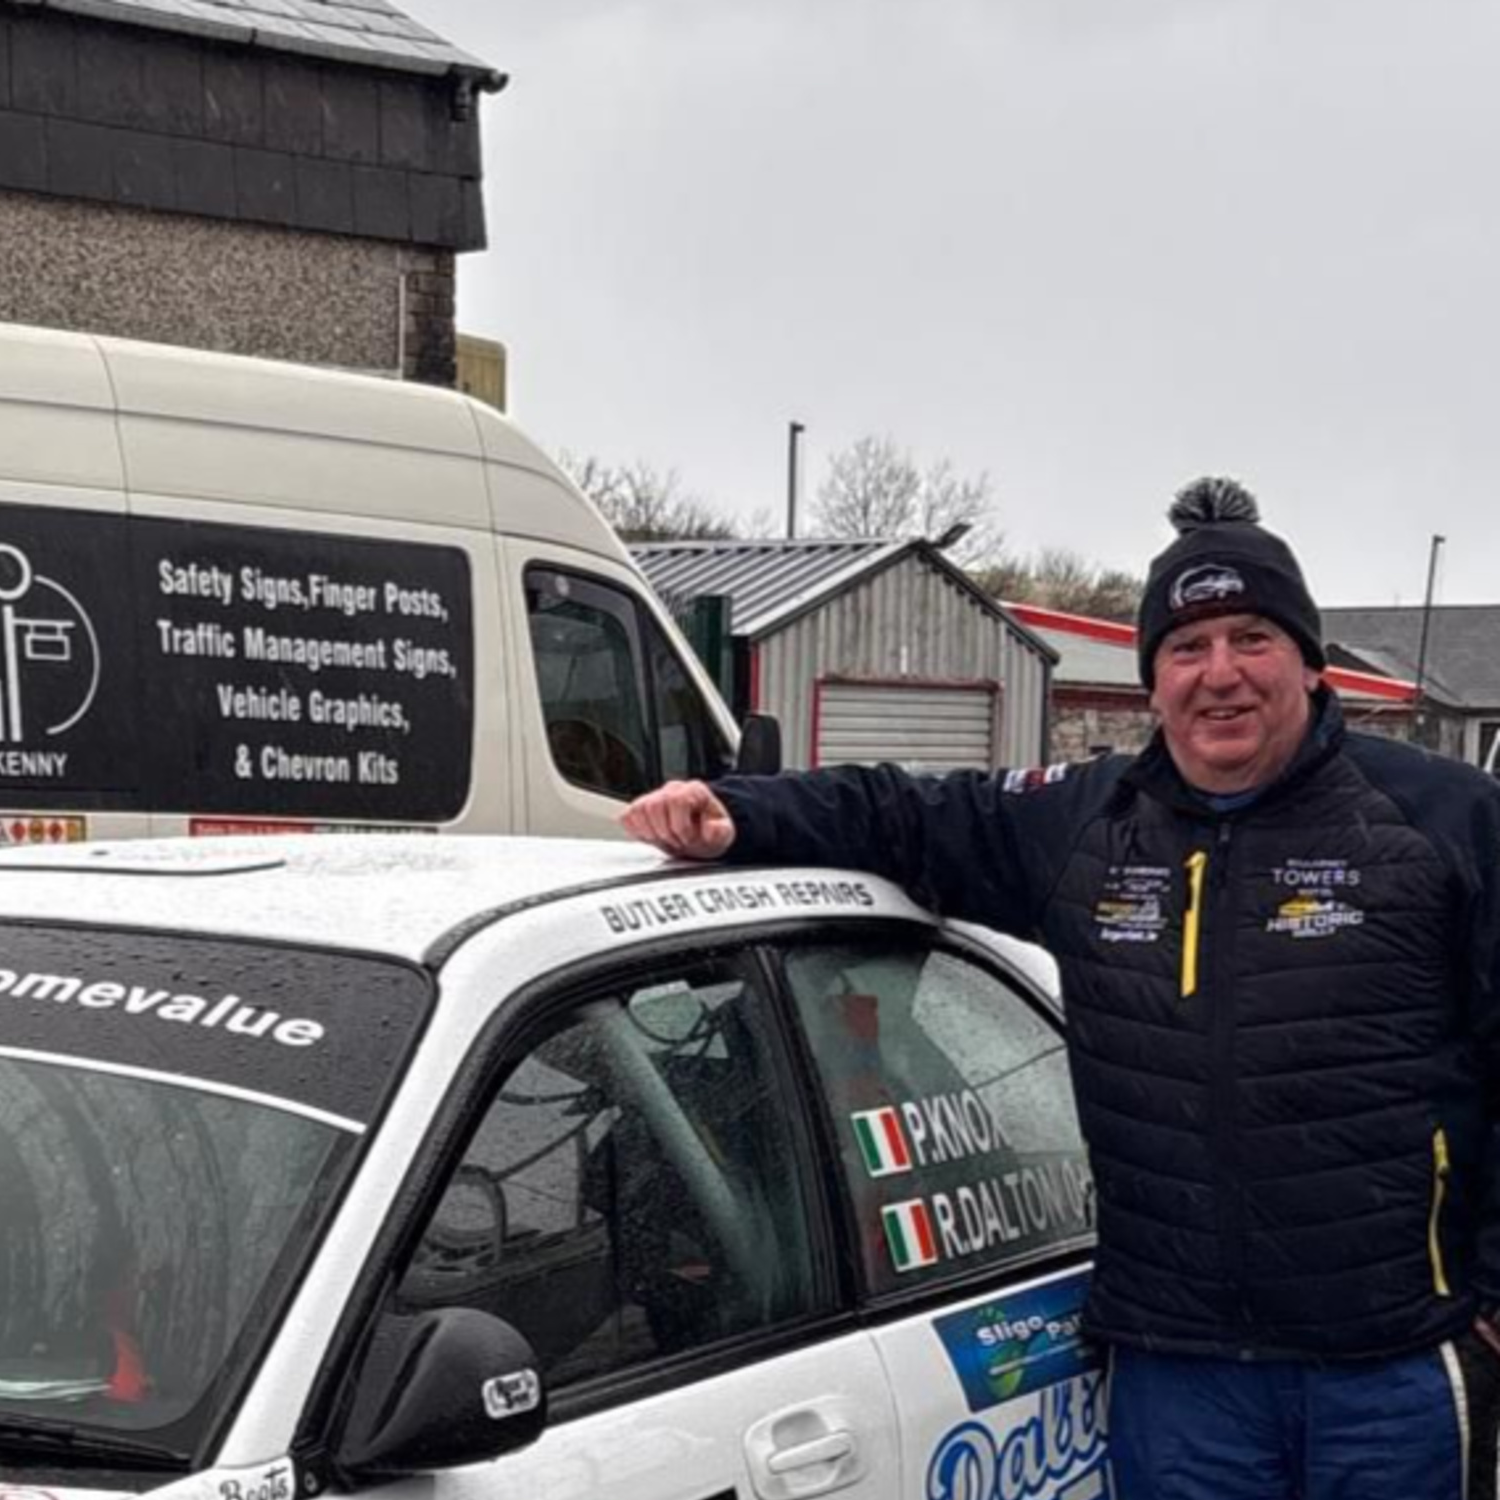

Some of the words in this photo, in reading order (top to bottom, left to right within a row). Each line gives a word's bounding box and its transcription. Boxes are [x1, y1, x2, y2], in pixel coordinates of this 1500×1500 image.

[158, 558, 233, 605] Safety
[384, 581, 449, 623] Posts,
[156, 619, 236, 658] Traffic
[243, 626, 386, 672] Management
[392, 637, 457, 680] Signs,
[216, 683, 301, 722] Vehicle
[308, 690, 411, 734] Graphics,
[234, 744, 252, 779] &
[260, 746, 351, 783] Chevron
[357, 751, 399, 785] Kits
[1270, 867, 1361, 886] TOWERS
[601, 889, 695, 934] BUTLER
[695, 885, 776, 914] CRASH
[777, 881, 875, 908] REPAIRS
[901, 1087, 1011, 1166] P.KNOX
[976, 1315, 1045, 1346] Sligo
[1046, 1312, 1083, 1341] Par
